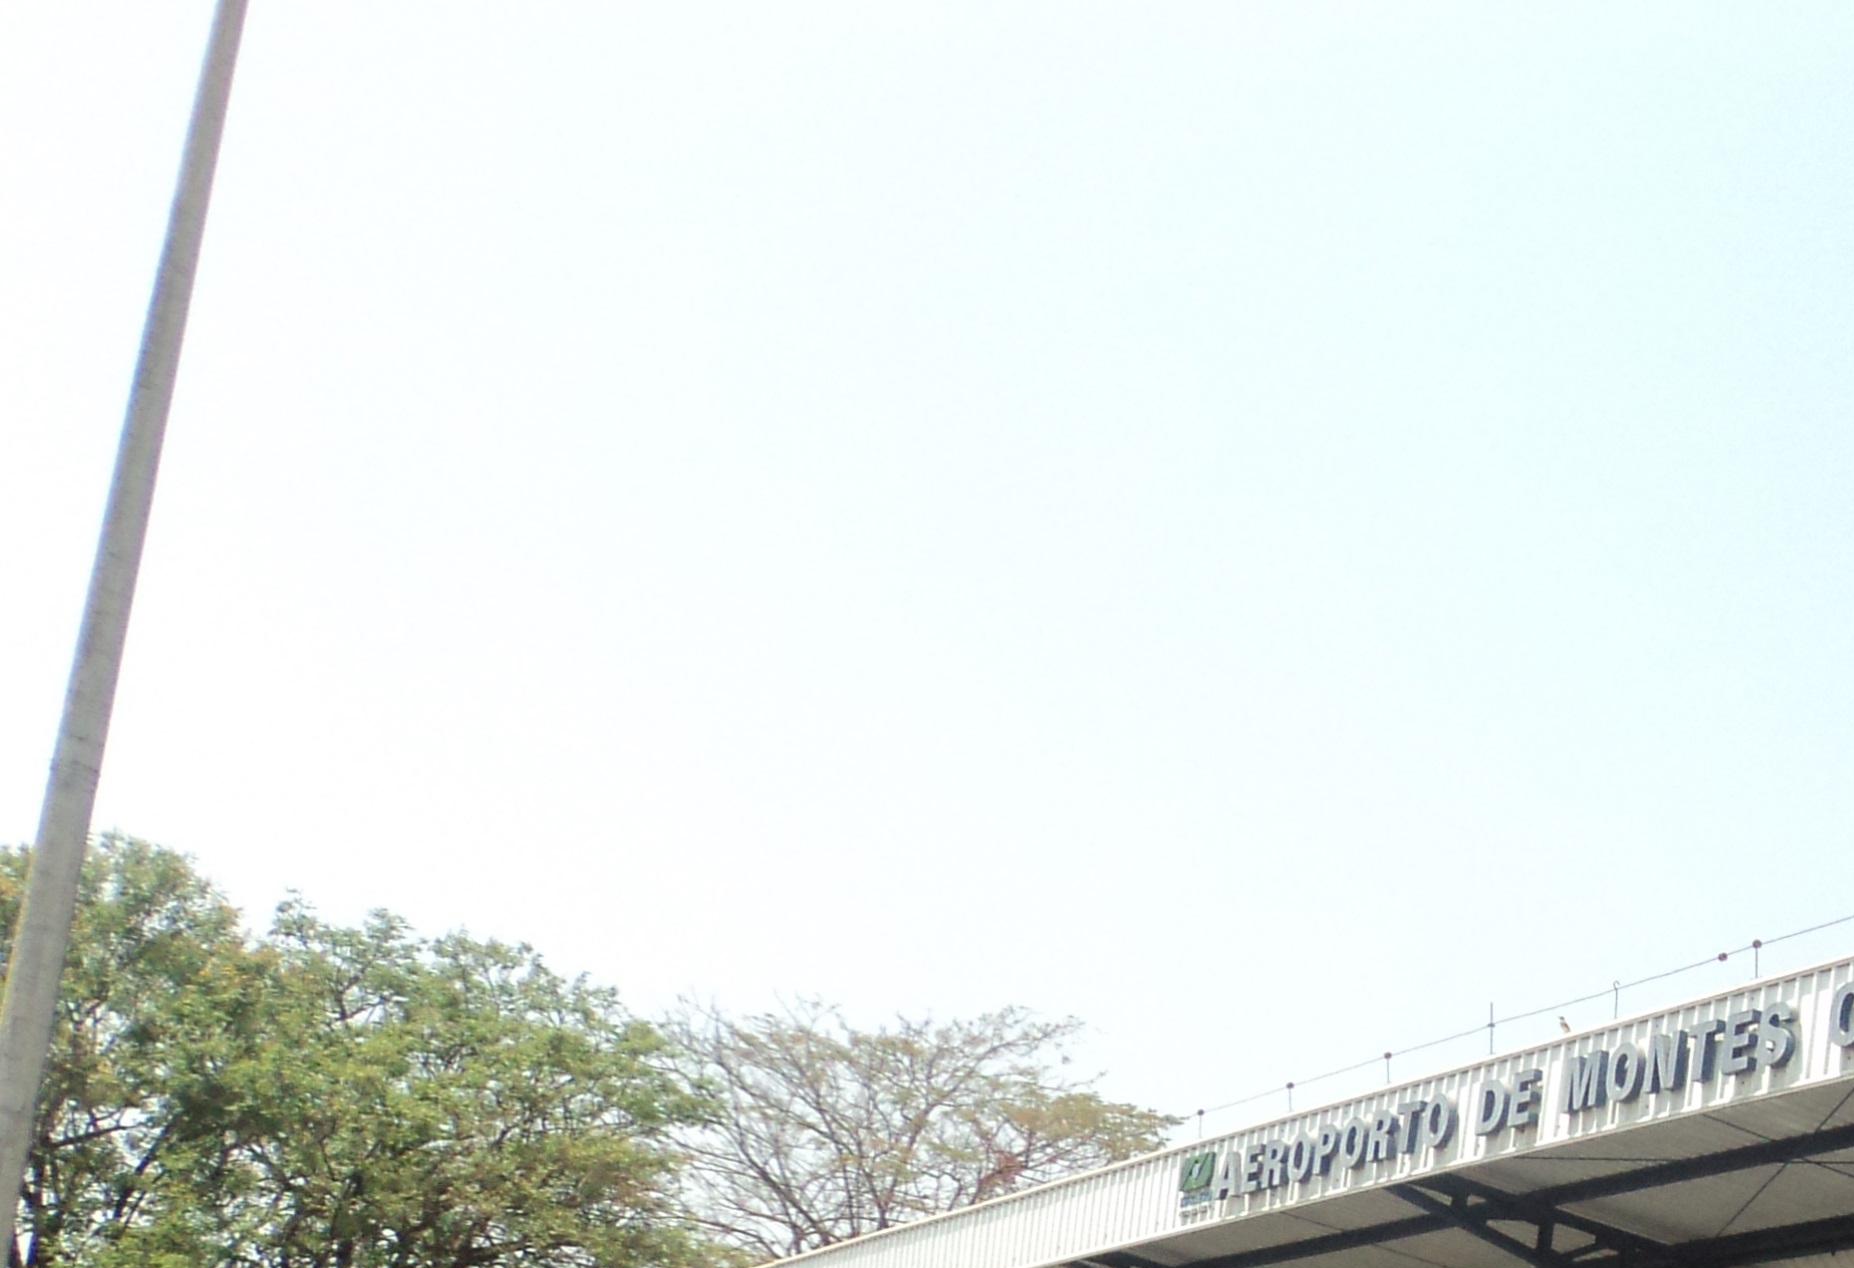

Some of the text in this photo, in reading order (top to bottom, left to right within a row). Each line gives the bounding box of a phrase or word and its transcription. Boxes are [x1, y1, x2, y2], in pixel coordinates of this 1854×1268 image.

[1213, 1093, 1459, 1201] AEROPORTO
[1475, 1068, 1542, 1136] DE
[1562, 1001, 1796, 1114] MONTES
